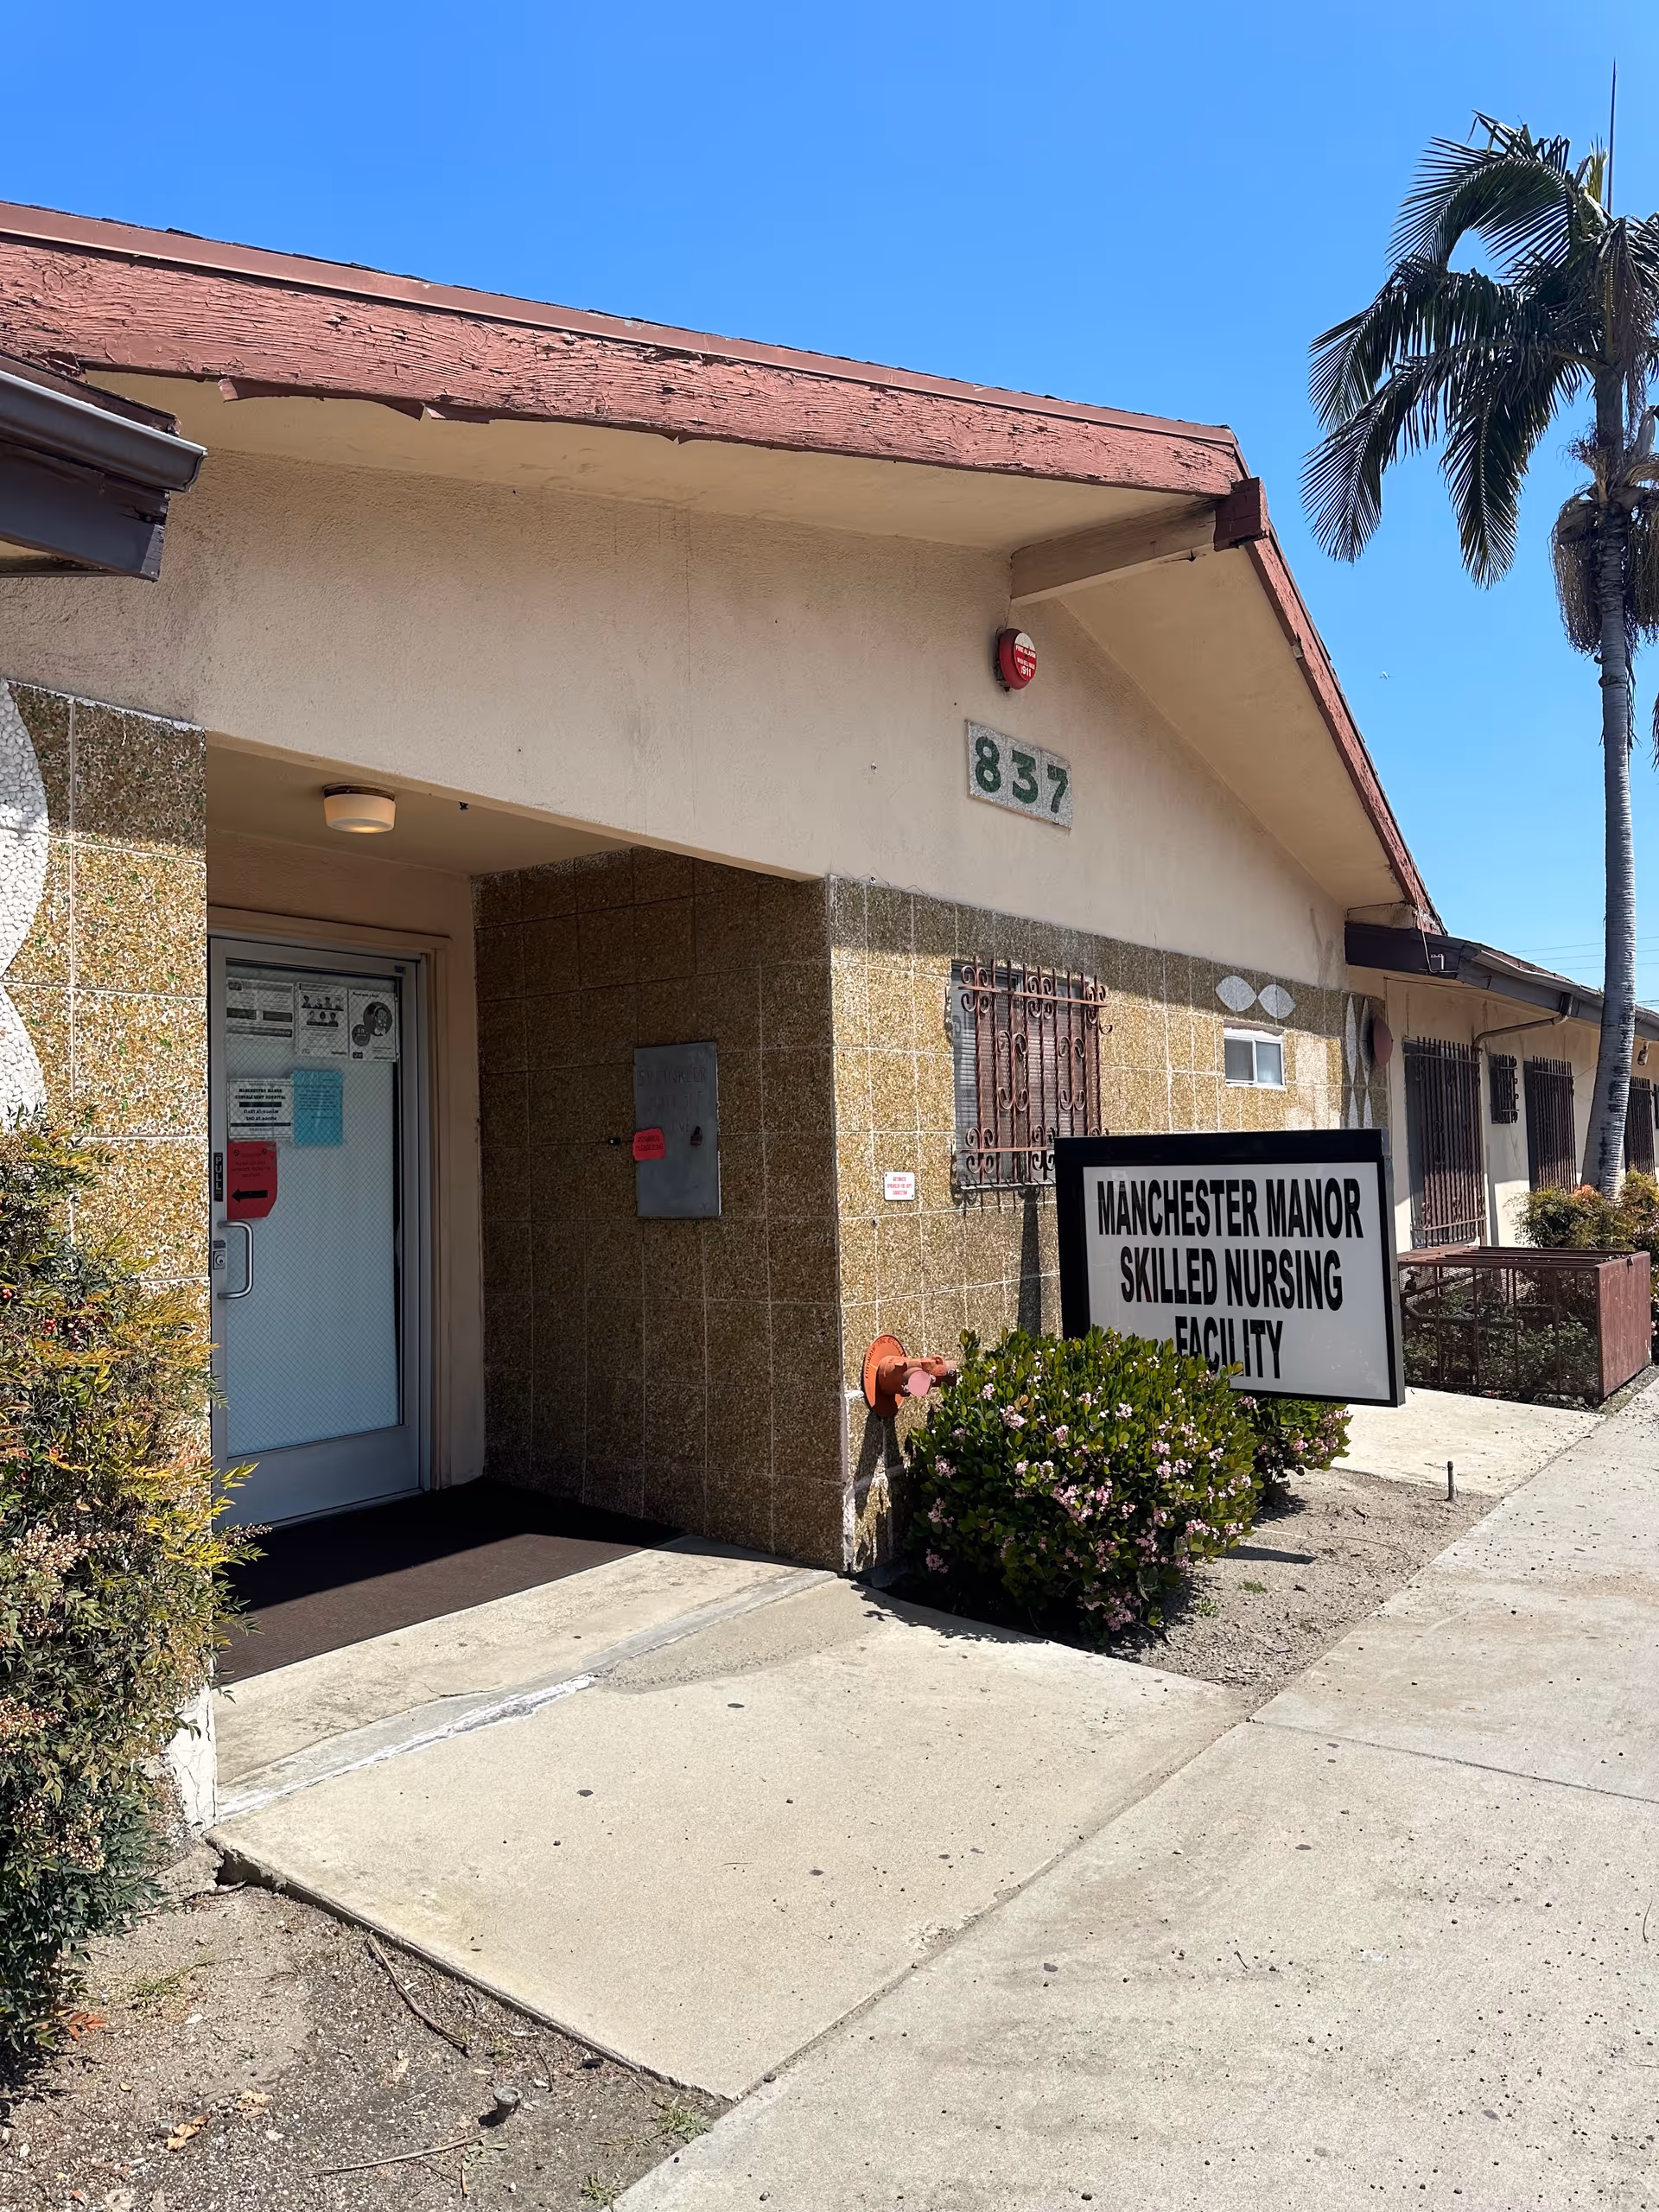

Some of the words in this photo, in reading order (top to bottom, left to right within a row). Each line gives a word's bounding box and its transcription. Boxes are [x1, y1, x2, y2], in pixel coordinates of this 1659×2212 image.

[1015, 645, 1024, 653] FIRE
[1022, 665, 1032, 677] 911
[975, 736, 1069, 814] 837
[1096, 1179, 1260, 1237] MANCHESTER
[1265, 1178, 1364, 1239] MANOR
[1120, 1246, 1218, 1306] SKILLED
[1224, 1248, 1343, 1312] NURSING
[1174, 1315, 1283, 1379] FACILITY
